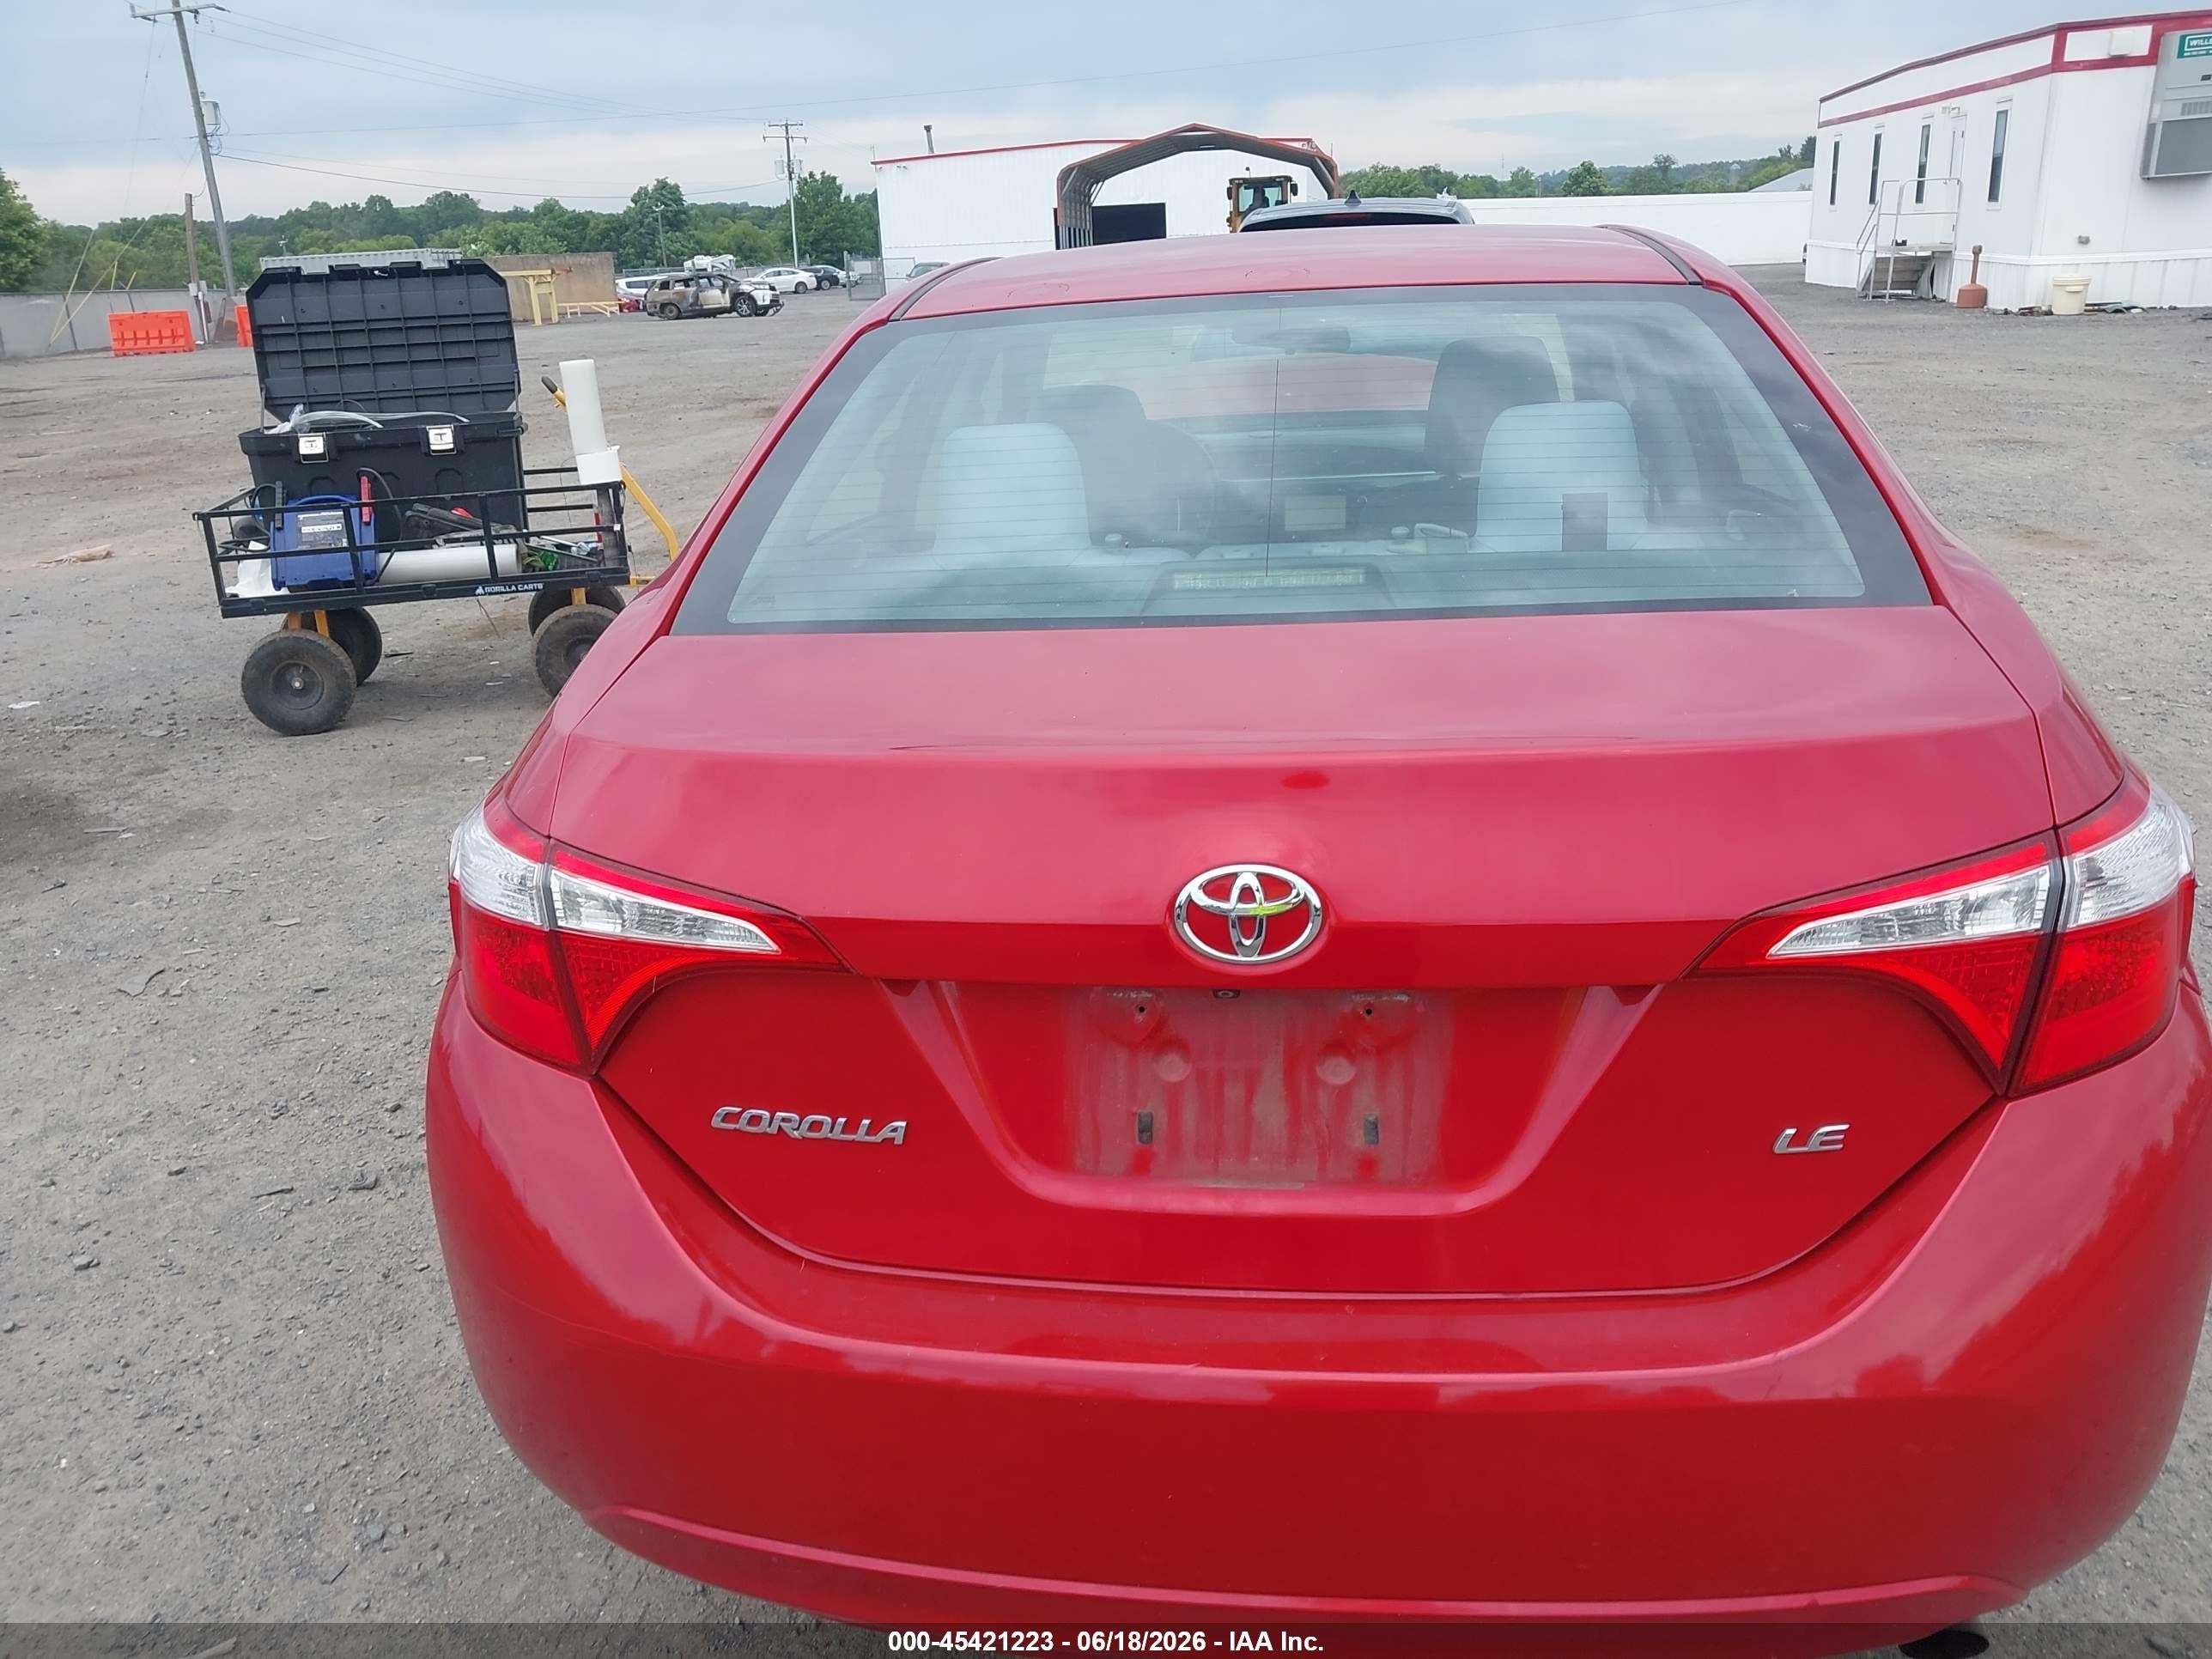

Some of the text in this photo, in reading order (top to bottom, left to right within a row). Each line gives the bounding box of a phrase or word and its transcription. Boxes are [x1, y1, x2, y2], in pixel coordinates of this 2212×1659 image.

[484, 585, 517, 593] GORILLA
[711, 1106, 907, 1145] COROLLA
[1773, 1123, 1850, 1154] LE
